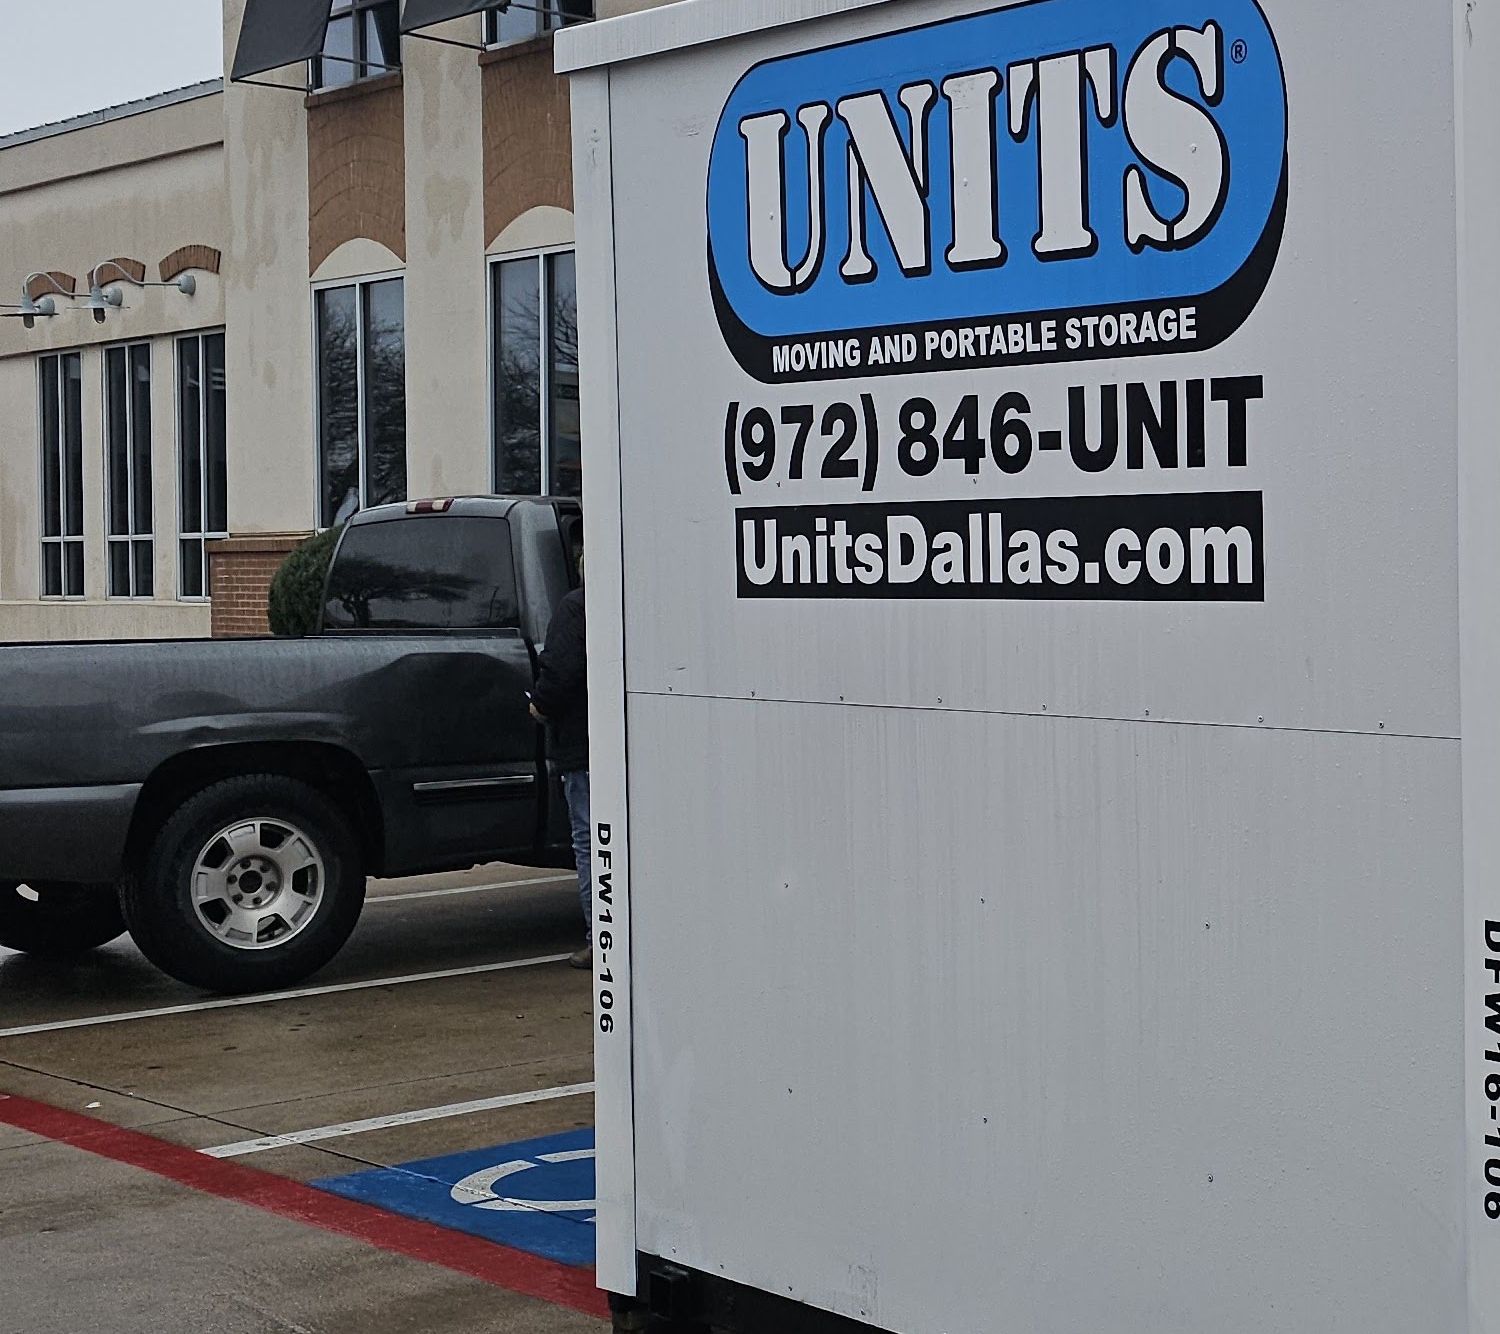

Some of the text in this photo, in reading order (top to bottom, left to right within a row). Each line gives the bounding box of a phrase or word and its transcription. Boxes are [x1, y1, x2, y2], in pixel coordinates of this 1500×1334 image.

[772, 306, 1197, 374] MOVING AND PORTABLE STORAGE
[724, 375, 1264, 495] (972) 846-UNIT
[741, 512, 1254, 587] UnitsDallas.com
[597, 822, 614, 1034] DFW16-106
